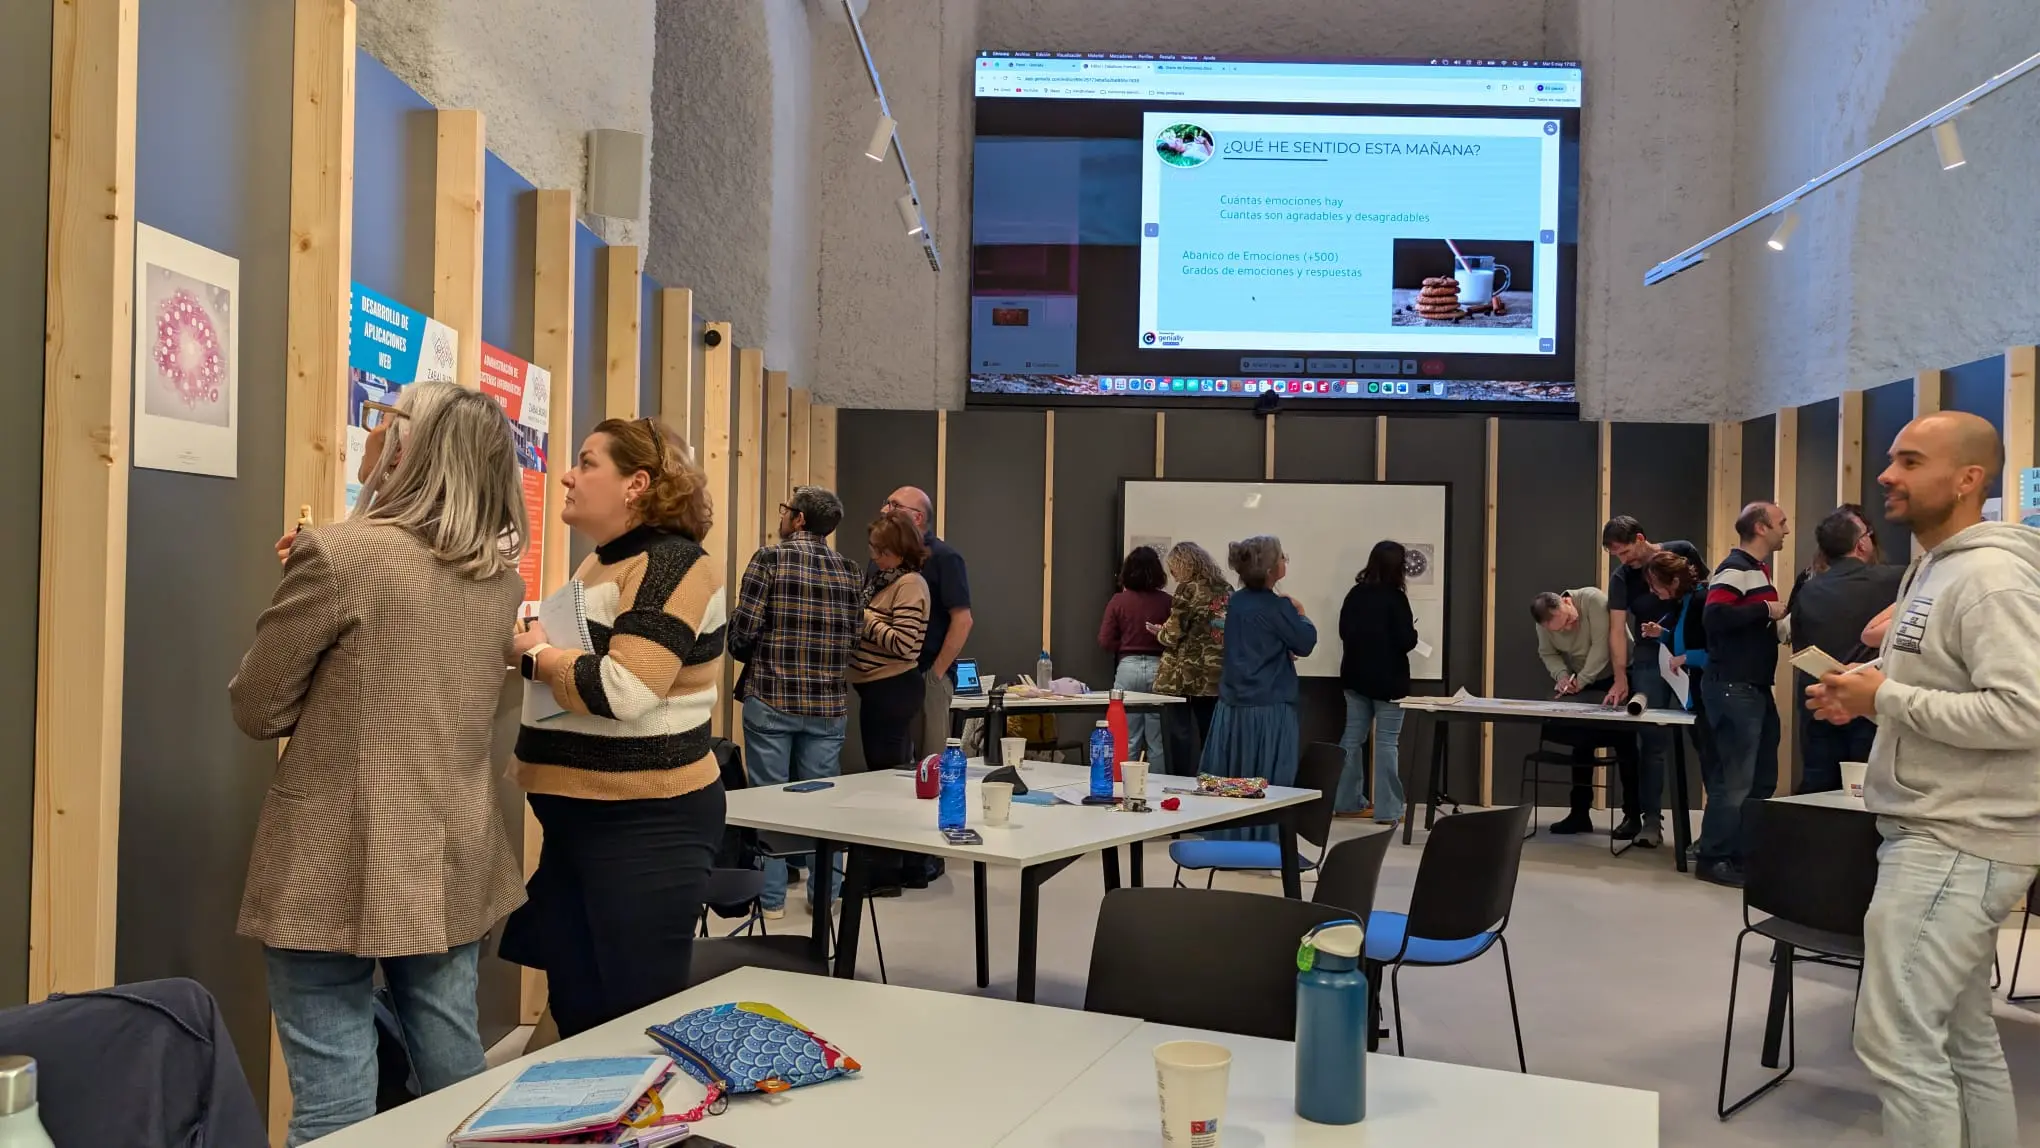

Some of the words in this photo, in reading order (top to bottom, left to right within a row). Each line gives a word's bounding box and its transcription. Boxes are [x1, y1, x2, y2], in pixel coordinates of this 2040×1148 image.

[1223, 138, 1264, 155] ¿QUÉ
[1268, 141, 1289, 153] HE
[1293, 141, 1361, 155] SENTIDO
[1365, 142, 1402, 155] ESTA
[1406, 142, 1481, 157] MAÑANA?
[1265, 197, 1322, 207] emociones
[1324, 197, 1344, 209] hay
[1264, 212, 1283, 220] son
[1286, 211, 1344, 222] agradables
[1346, 214, 1352, 223] y
[1354, 212, 1430, 224] desagradables
[1182, 250, 1224, 260] Abanico
[1227, 251, 1240, 260] de
[1243, 252, 1300, 262] Emociones
[1303, 252, 1339, 264] (+500)
[1182, 266, 1219, 275] Grados
[1222, 266, 1235, 275] de
[1237, 267, 1294, 276] emociones
[1297, 268, 1302, 278] y
[1306, 268, 1362, 278] respuestas
[362, 296, 400, 327] DESARROLLO
[400, 314, 409, 331] DE
[364, 321, 407, 352] APLICACIONES
[378, 352, 392, 370] WEB
